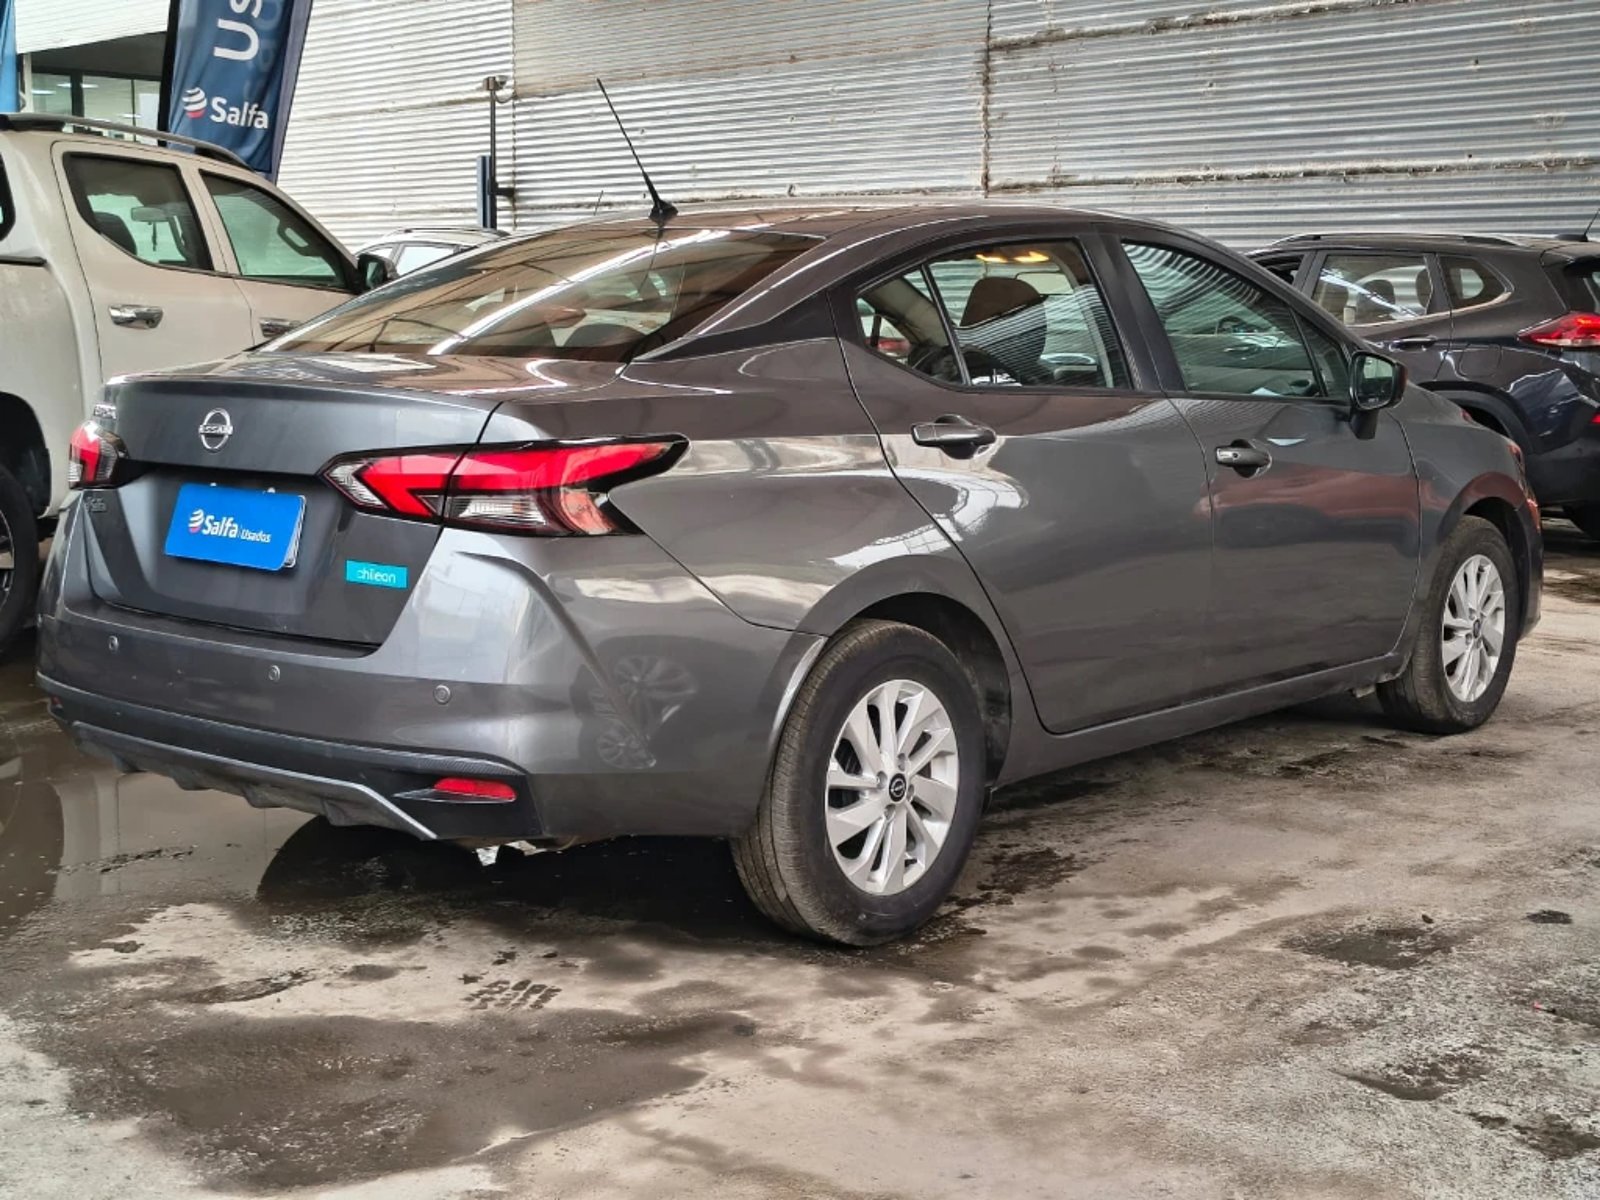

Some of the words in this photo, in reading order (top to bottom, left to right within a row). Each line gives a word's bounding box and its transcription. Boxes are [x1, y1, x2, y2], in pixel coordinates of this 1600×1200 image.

[210, 96, 268, 129] Salfa
[202, 514, 239, 538] Salfa
[240, 528, 271, 543] Usados
